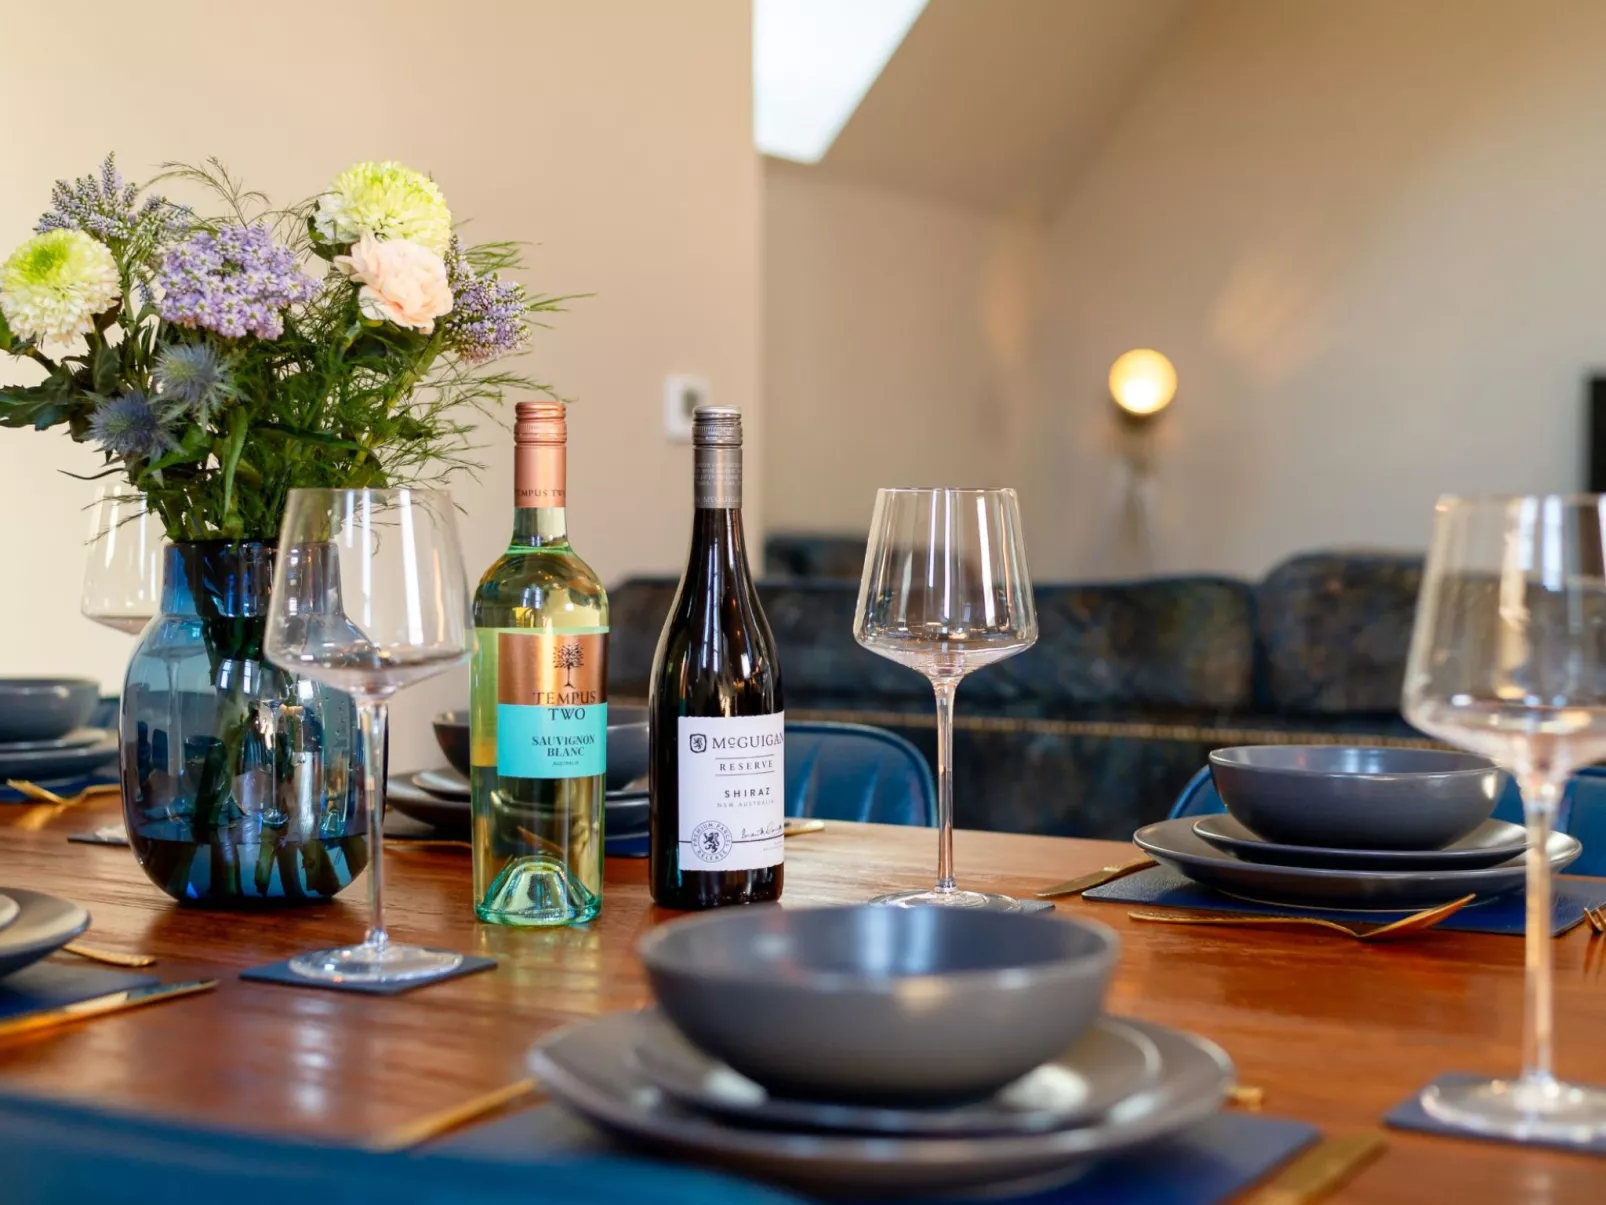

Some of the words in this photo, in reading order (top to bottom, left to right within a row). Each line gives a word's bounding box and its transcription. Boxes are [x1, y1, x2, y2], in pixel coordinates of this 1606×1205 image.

[532, 691, 597, 705] TEMPUS
[548, 707, 586, 721] TWO
[532, 735, 595, 746] SAUVIGNON
[547, 747, 585, 757] BLANC
[719, 760, 773, 771] RESERVE
[724, 787, 770, 798] SHIRAZ
